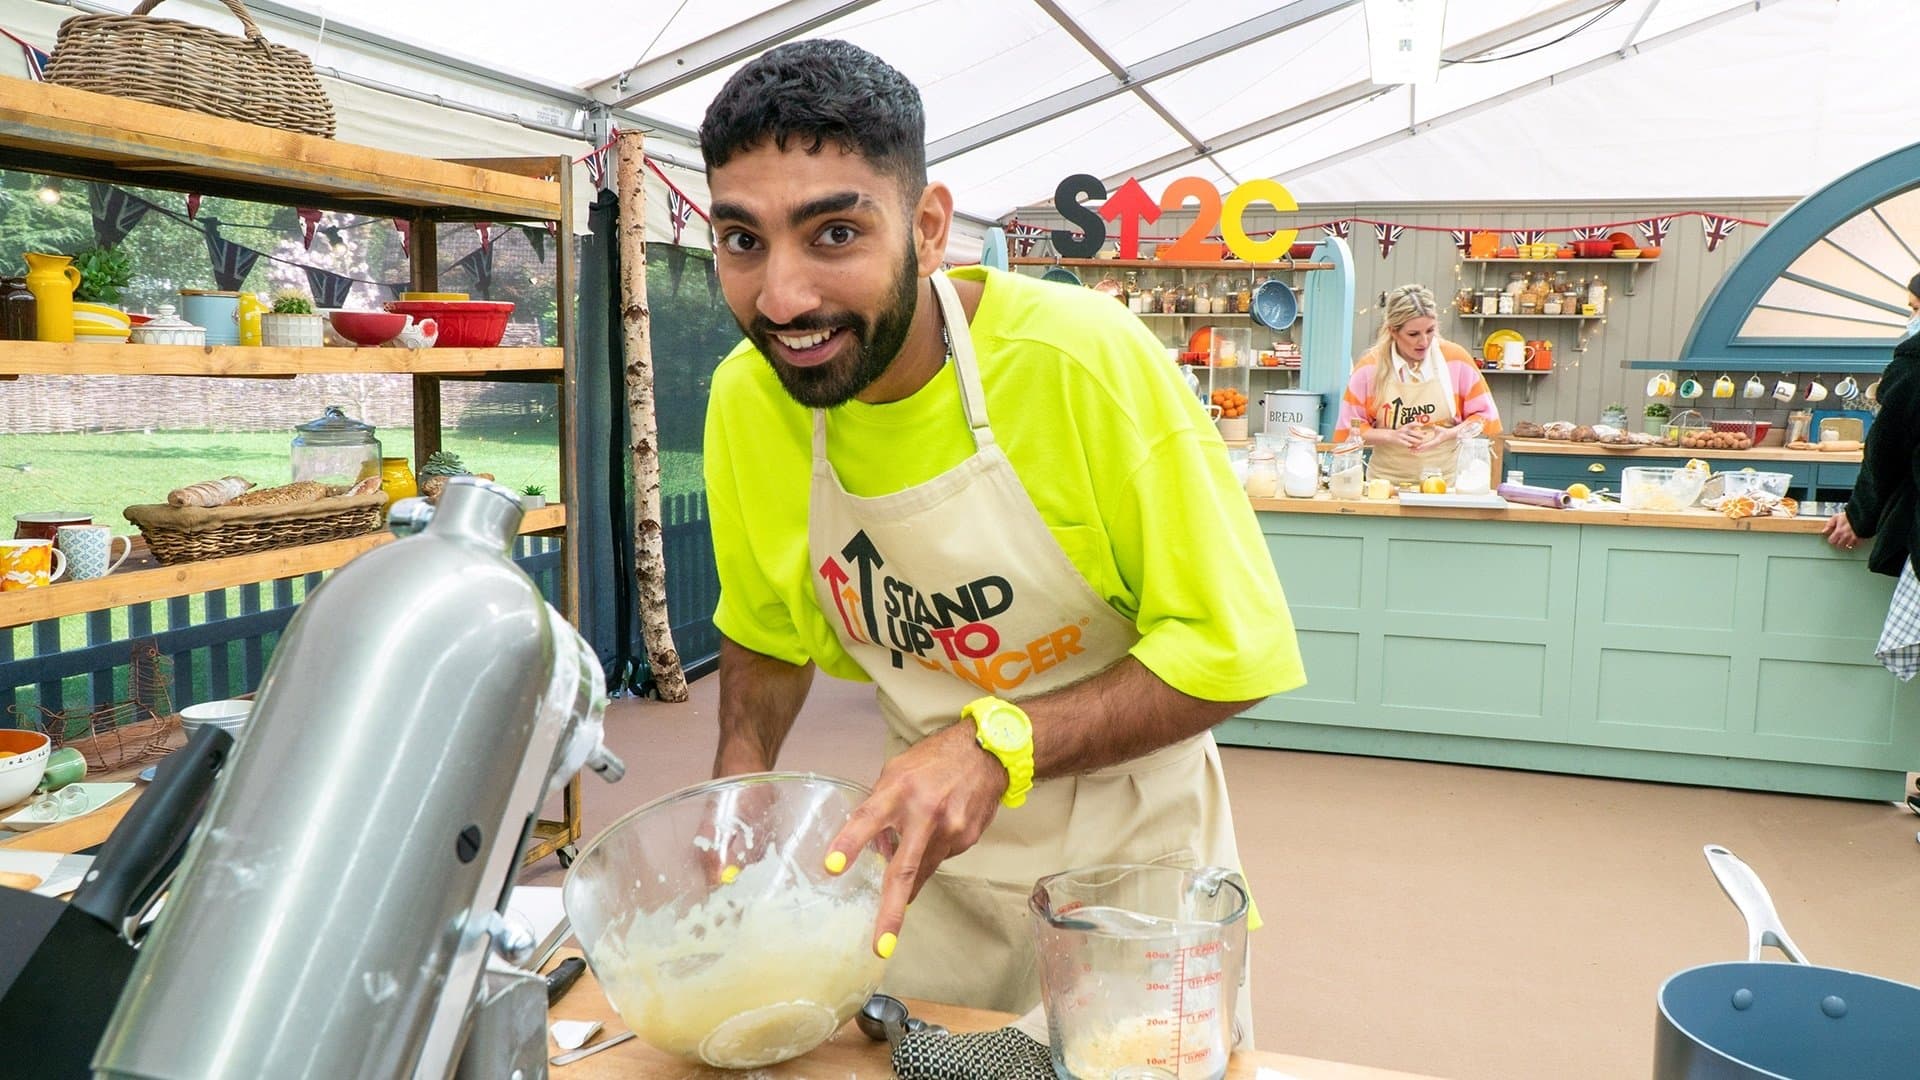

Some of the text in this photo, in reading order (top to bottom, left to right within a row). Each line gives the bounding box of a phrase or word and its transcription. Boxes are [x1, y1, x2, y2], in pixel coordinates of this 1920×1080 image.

[1269, 411, 1304, 423] BREAD
[1401, 404, 1435, 417] STAND
[1400, 416, 1415, 425] UP
[1415, 415, 1430, 424] TO
[884, 576, 1014, 630] STAND
[887, 614, 1000, 662] UP TO
